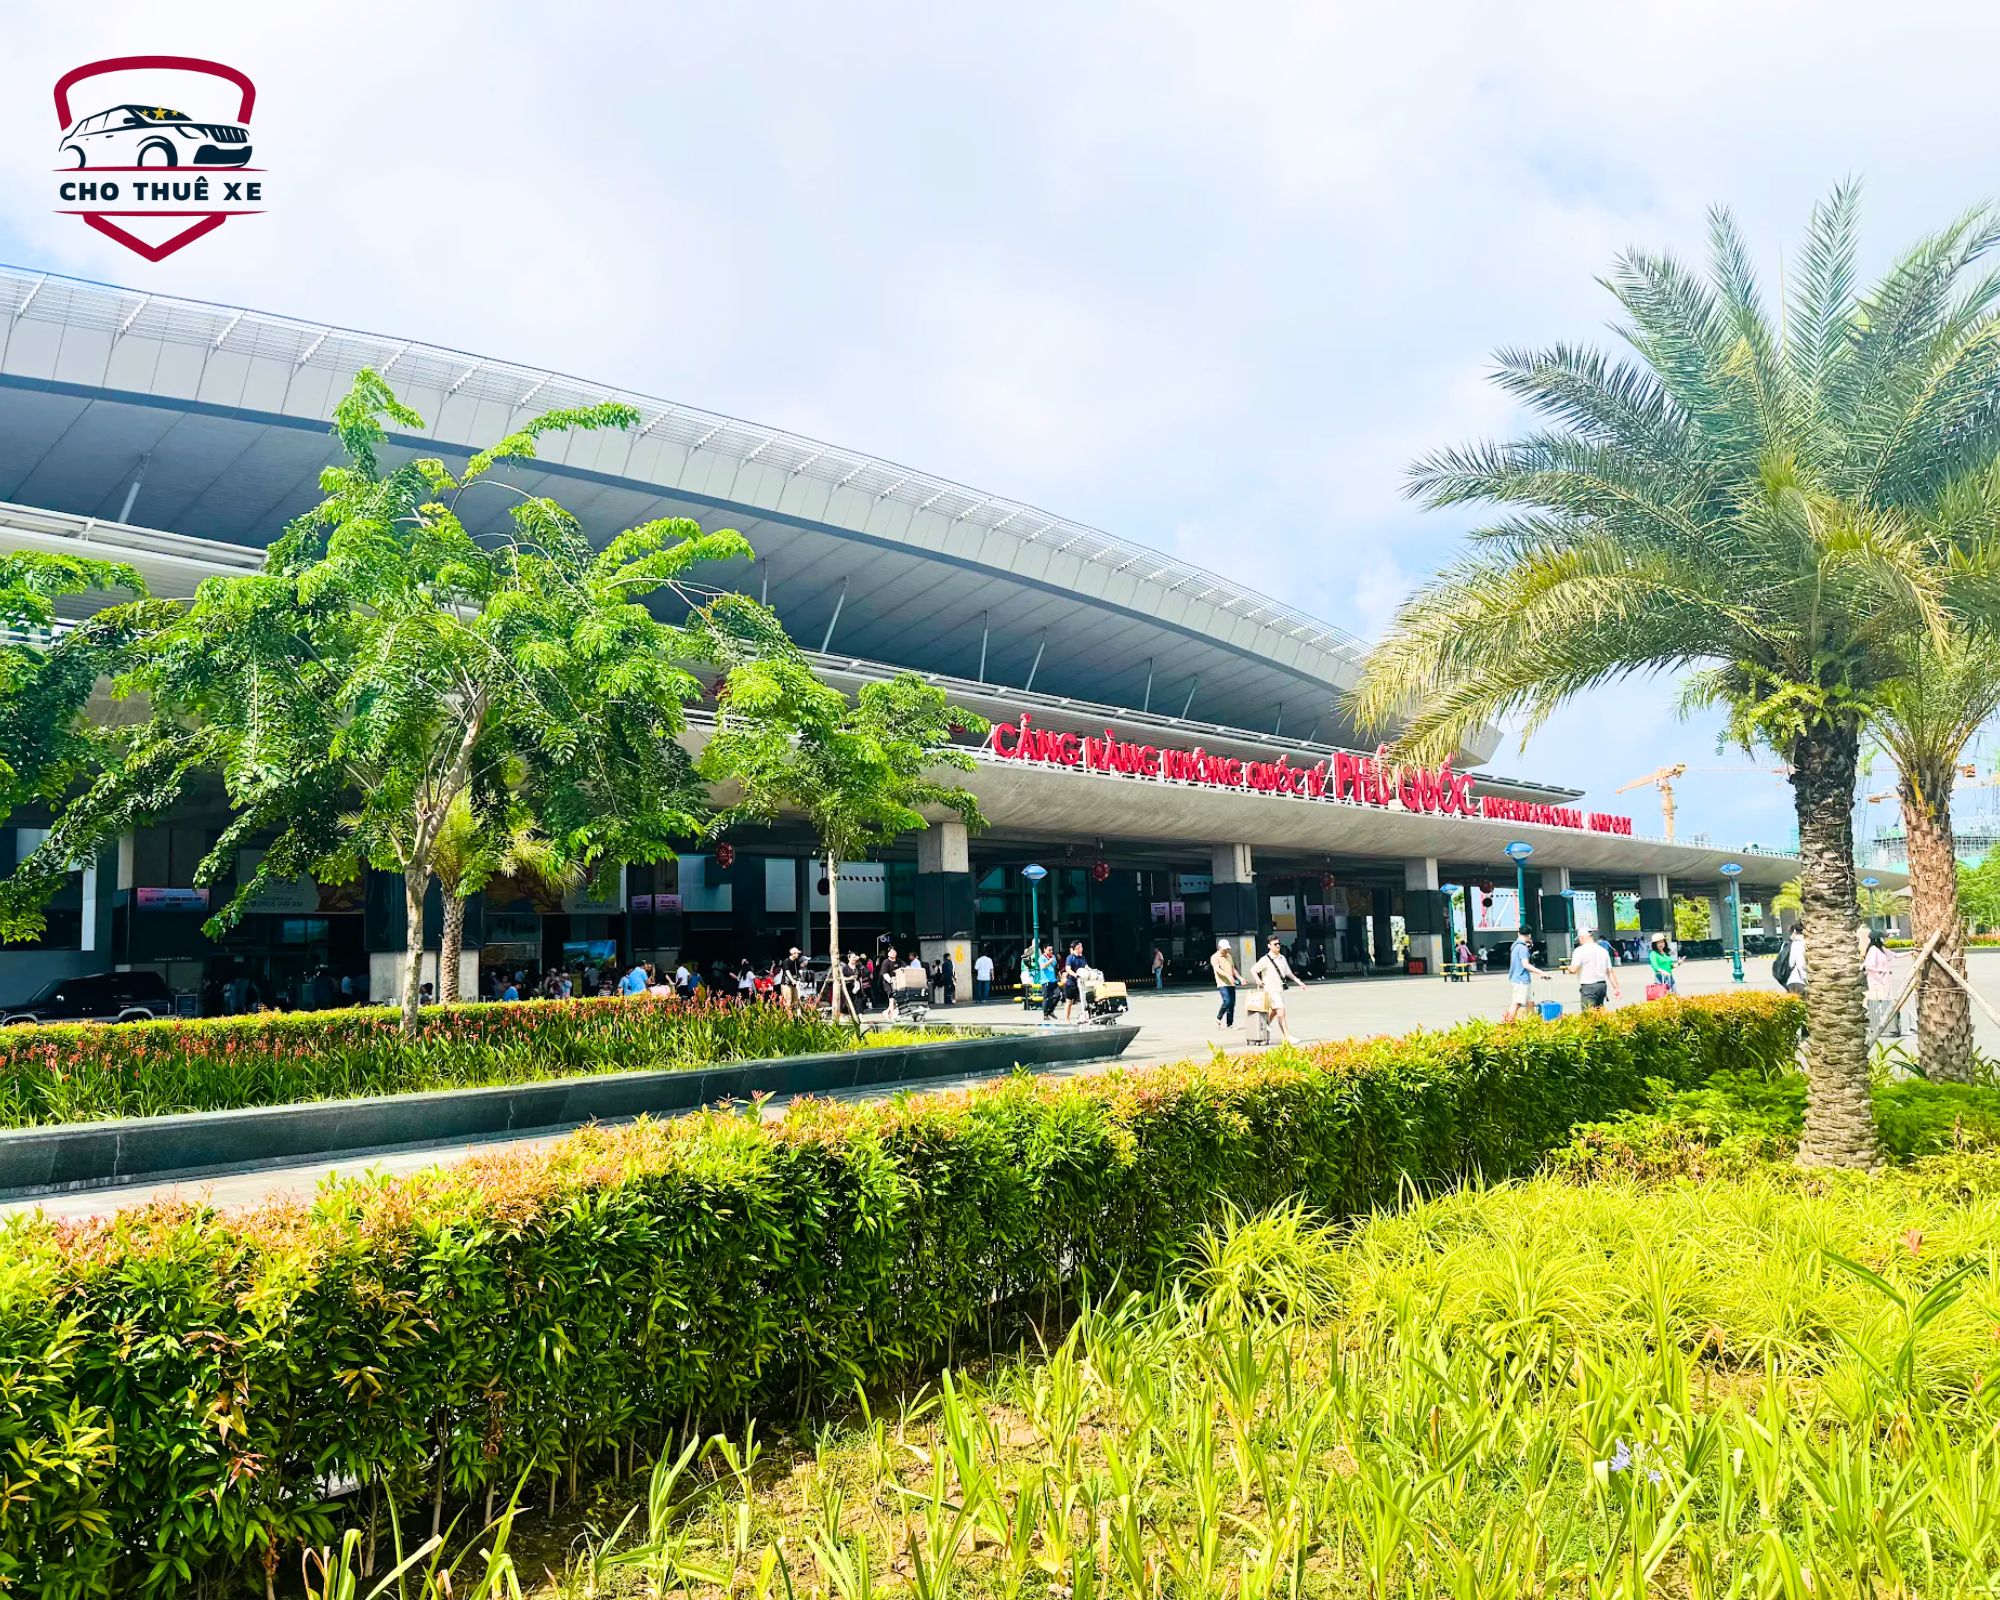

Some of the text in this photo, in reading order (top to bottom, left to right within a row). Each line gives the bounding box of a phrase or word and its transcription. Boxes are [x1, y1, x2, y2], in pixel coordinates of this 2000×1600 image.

[992, 712, 1080, 765] CẢNG
[1084, 728, 1159, 776] HÀNG
[1163, 746, 1242, 786] KHÔNG
[1246, 753, 1304, 794] QUỐC
[1482, 795, 1584, 829] INTERNATIONAL
